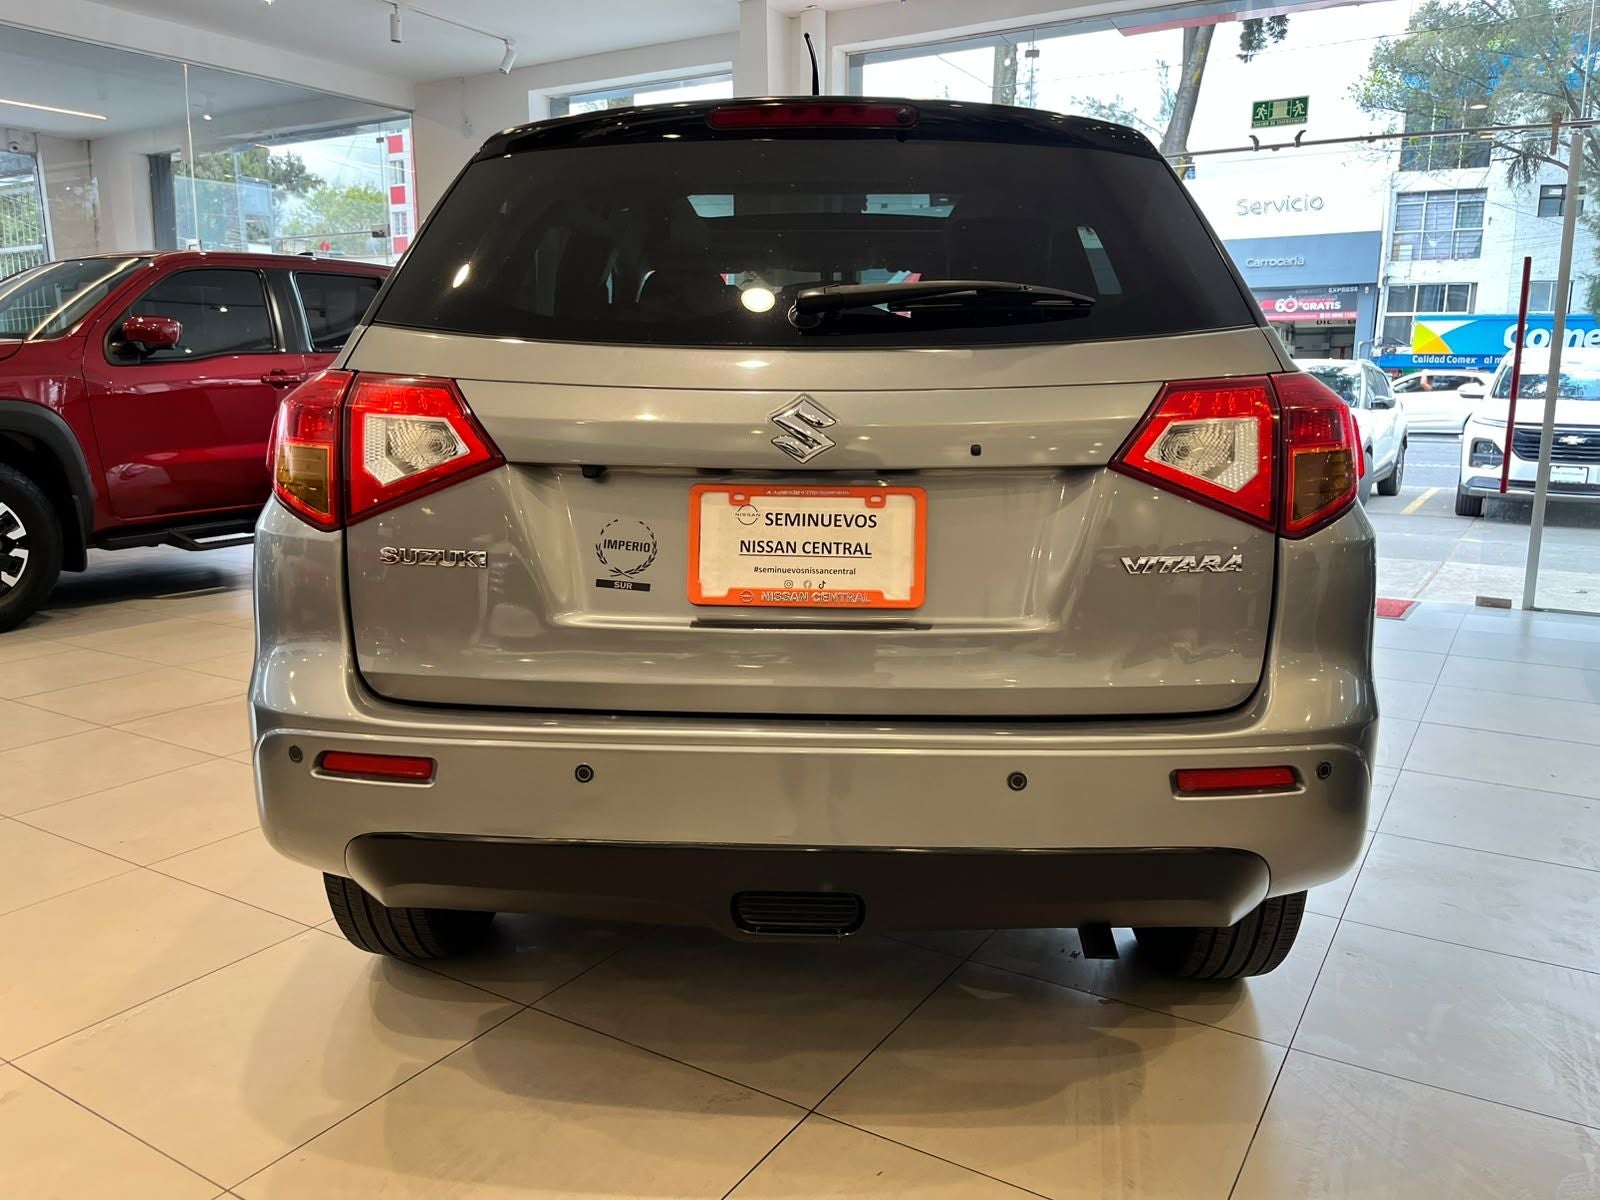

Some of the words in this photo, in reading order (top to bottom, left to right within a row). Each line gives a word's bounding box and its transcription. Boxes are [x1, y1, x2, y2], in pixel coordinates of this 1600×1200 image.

[1236, 194, 1324, 216] Servicio
[1302, 301, 1342, 311] GRATIS
[1412, 355, 1445, 364] Calidad
[1446, 355, 1476, 364] Comex
[764, 511, 878, 529] SEMINUEVOS
[603, 539, 651, 552] IMPERIO
[739, 539, 797, 554] NISSAN
[801, 541, 873, 556] CENTRAL
[379, 546, 489, 568] SUZUKI
[1120, 553, 1243, 574] VITARA
[753, 565, 857, 576] #seminuevosnissancentral
[613, 581, 633, 590] SUR
[761, 591, 809, 602] NISSAN
[811, 592, 871, 603] CENTRAL
